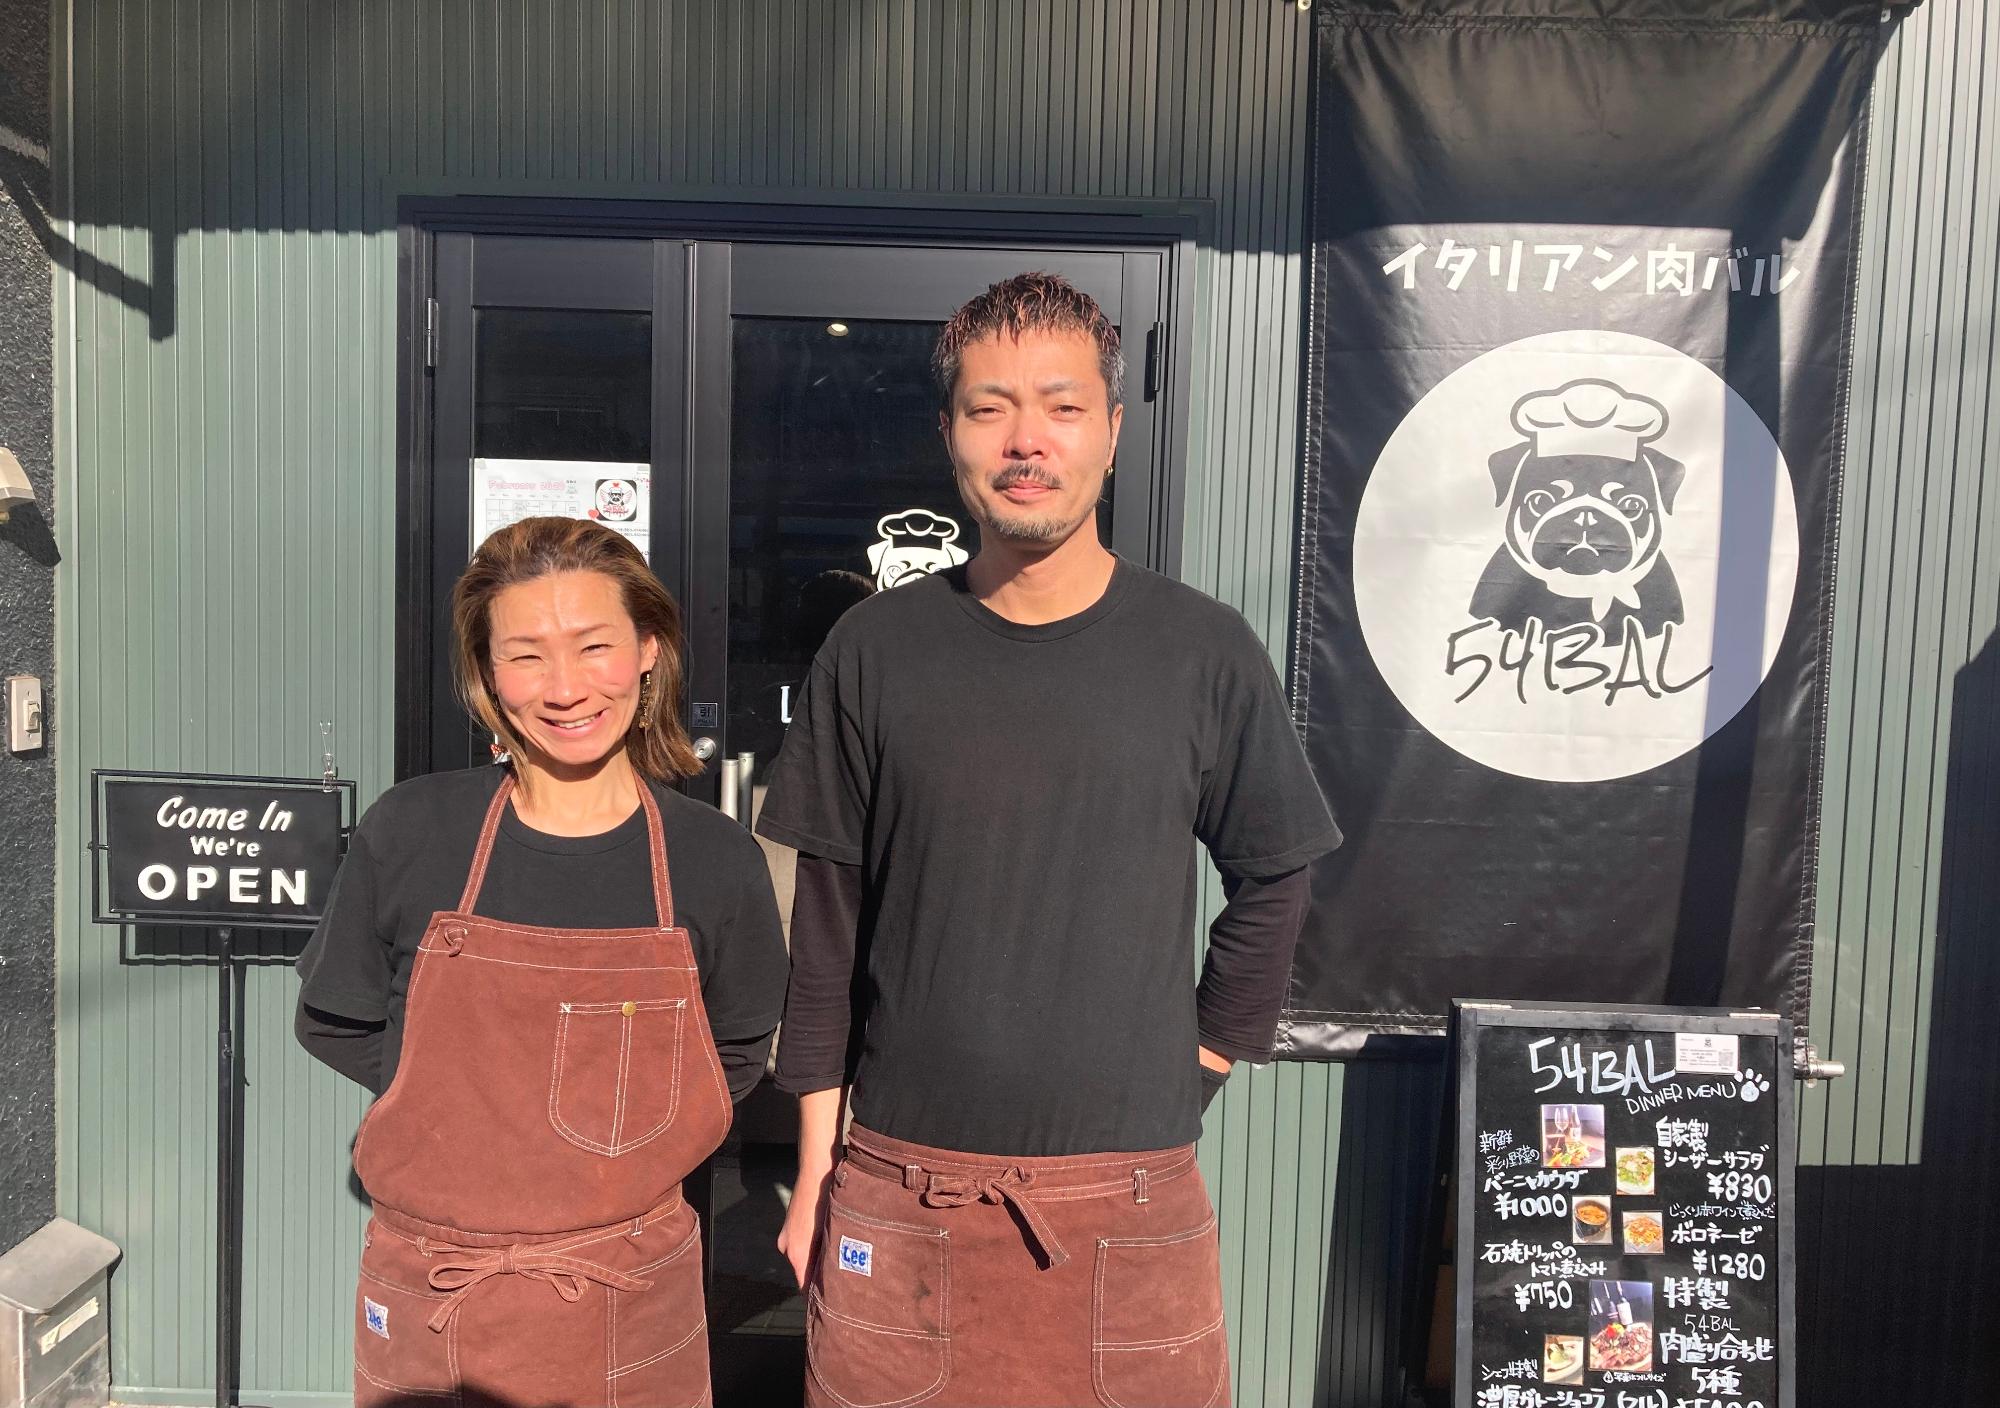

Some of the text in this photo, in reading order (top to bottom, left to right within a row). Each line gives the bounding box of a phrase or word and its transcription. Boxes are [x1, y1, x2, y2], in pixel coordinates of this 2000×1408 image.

[1383, 239, 1800, 297] イタリアン肉バル
[1444, 617, 1714, 707] 54BAL
[156, 795, 293, 832] Come In
[190, 836, 261, 857] We're
[137, 863, 307, 905] OPEN
[1529, 1036, 1677, 1096] 54BAL
[1626, 1081, 1737, 1115] DINNER MENU
[1479, 1129, 1513, 1154] 新鮮
[1656, 1115, 1709, 1152] 自家製
[1663, 1144, 1770, 1170] シーザーサラダ
[1483, 1169, 1589, 1193] バーニャカウダ
[1706, 1170, 1772, 1204] ¥830
[1493, 1191, 1568, 1221] ¥1000
[1670, 1220, 1763, 1244] ボロネーゼ
[843, 1245, 867, 1267] Lee
[1480, 1239, 1577, 1264] 石焼トリッパの
[1692, 1248, 1766, 1281] ¥1280
[1531, 1257, 1608, 1279] トマト煮込み
[1514, 1280, 1573, 1312] ¥750
[1663, 1276, 1732, 1311] 特製
[1659, 1327, 1774, 1365] 肉盛り合わせ
[1481, 1358, 1539, 1381] シェフ特製
[1691, 1365, 1743, 1396] 5種
